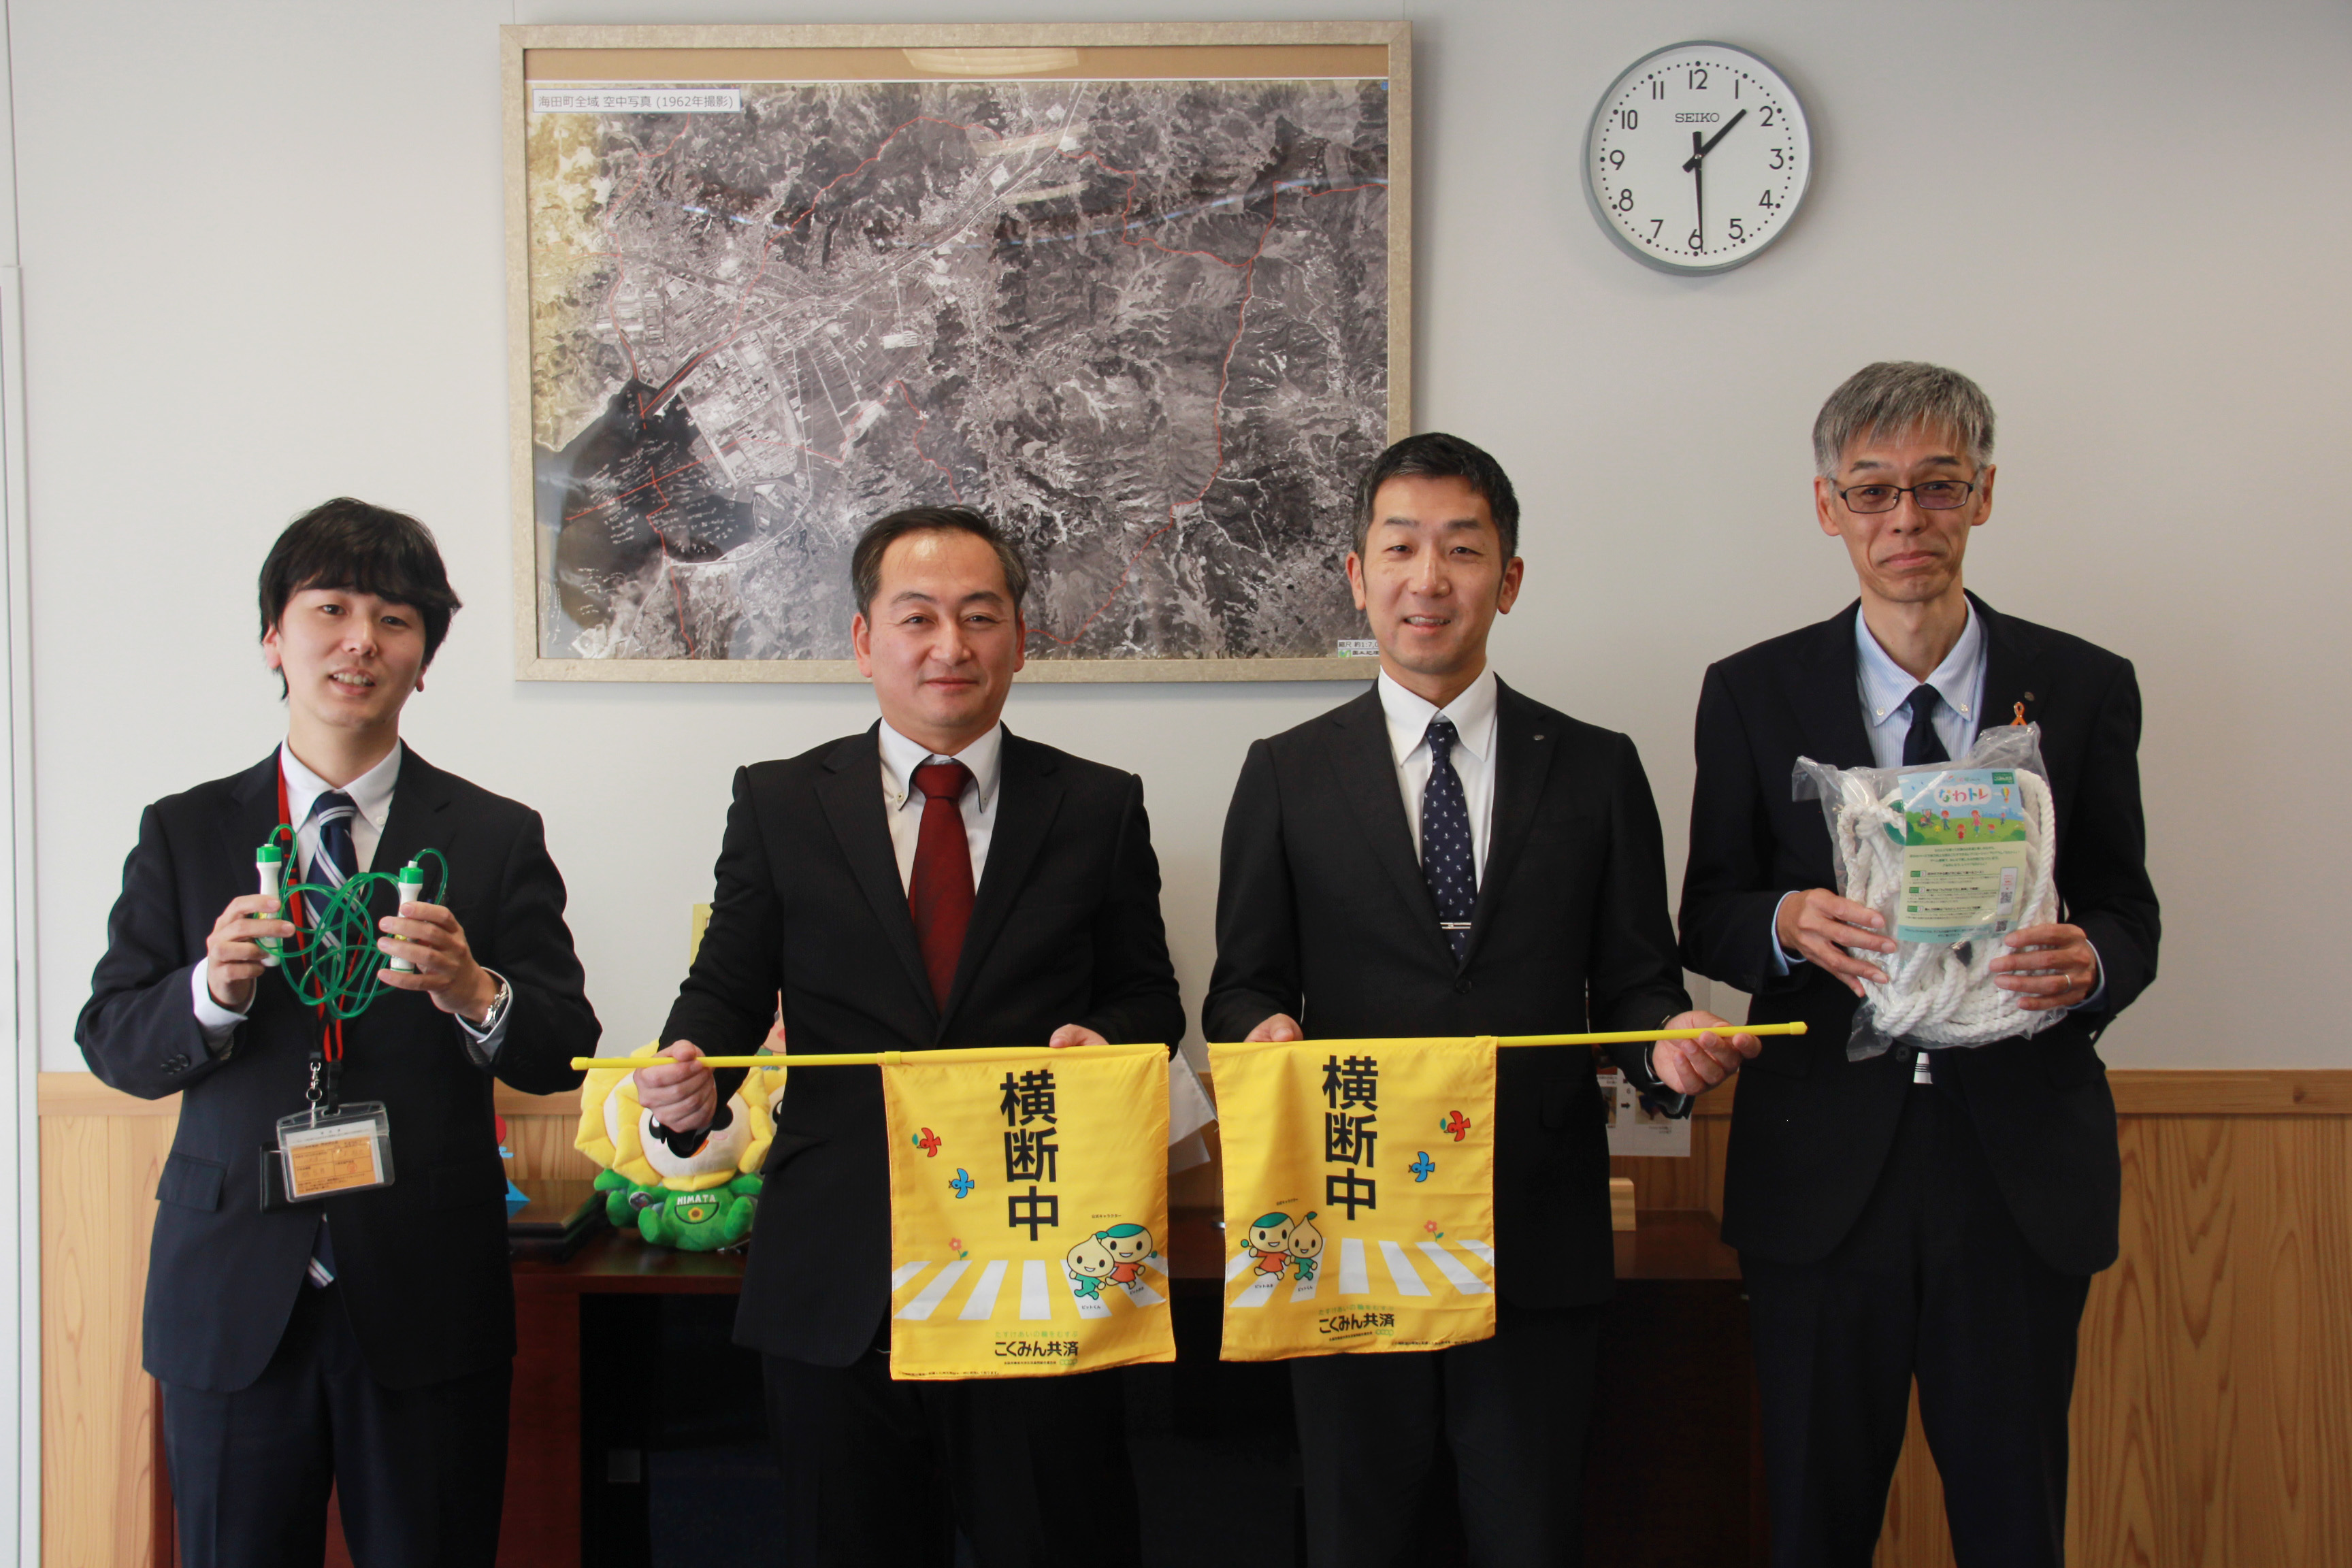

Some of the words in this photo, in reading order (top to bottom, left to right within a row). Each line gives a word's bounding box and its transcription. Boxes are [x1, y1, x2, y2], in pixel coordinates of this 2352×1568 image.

[1688, 69, 1708, 90] 12
[1735, 79, 1739, 99] 1
[1652, 80, 1664, 100] 11
[538, 96, 599, 108] 海田町全域
[603, 96, 651, 108] 空中写真
[1621, 110, 1638, 130] 10
[1675, 112, 1720, 122] SEIKO
[1759, 105, 1774, 127] 2
[1610, 150, 1625, 170] 9
[1769, 148, 1784, 169] 3
[1618, 189, 1634, 212] 8
[1758, 190, 1774, 209] 4
[1650, 219, 1664, 238] 7
[1728, 218, 1743, 240] 5
[1688, 229, 1703, 250] 6
[1939, 787, 1989, 802] なわトレ
[1322, 1055, 1379, 1221] 横断中
[1000, 1068, 1059, 1241] 横断中
[677, 1194, 716, 1205] HIMATA
[1319, 1312, 1394, 1333] こくみん共済
[995, 1341, 1079, 1356] こくみん共済
